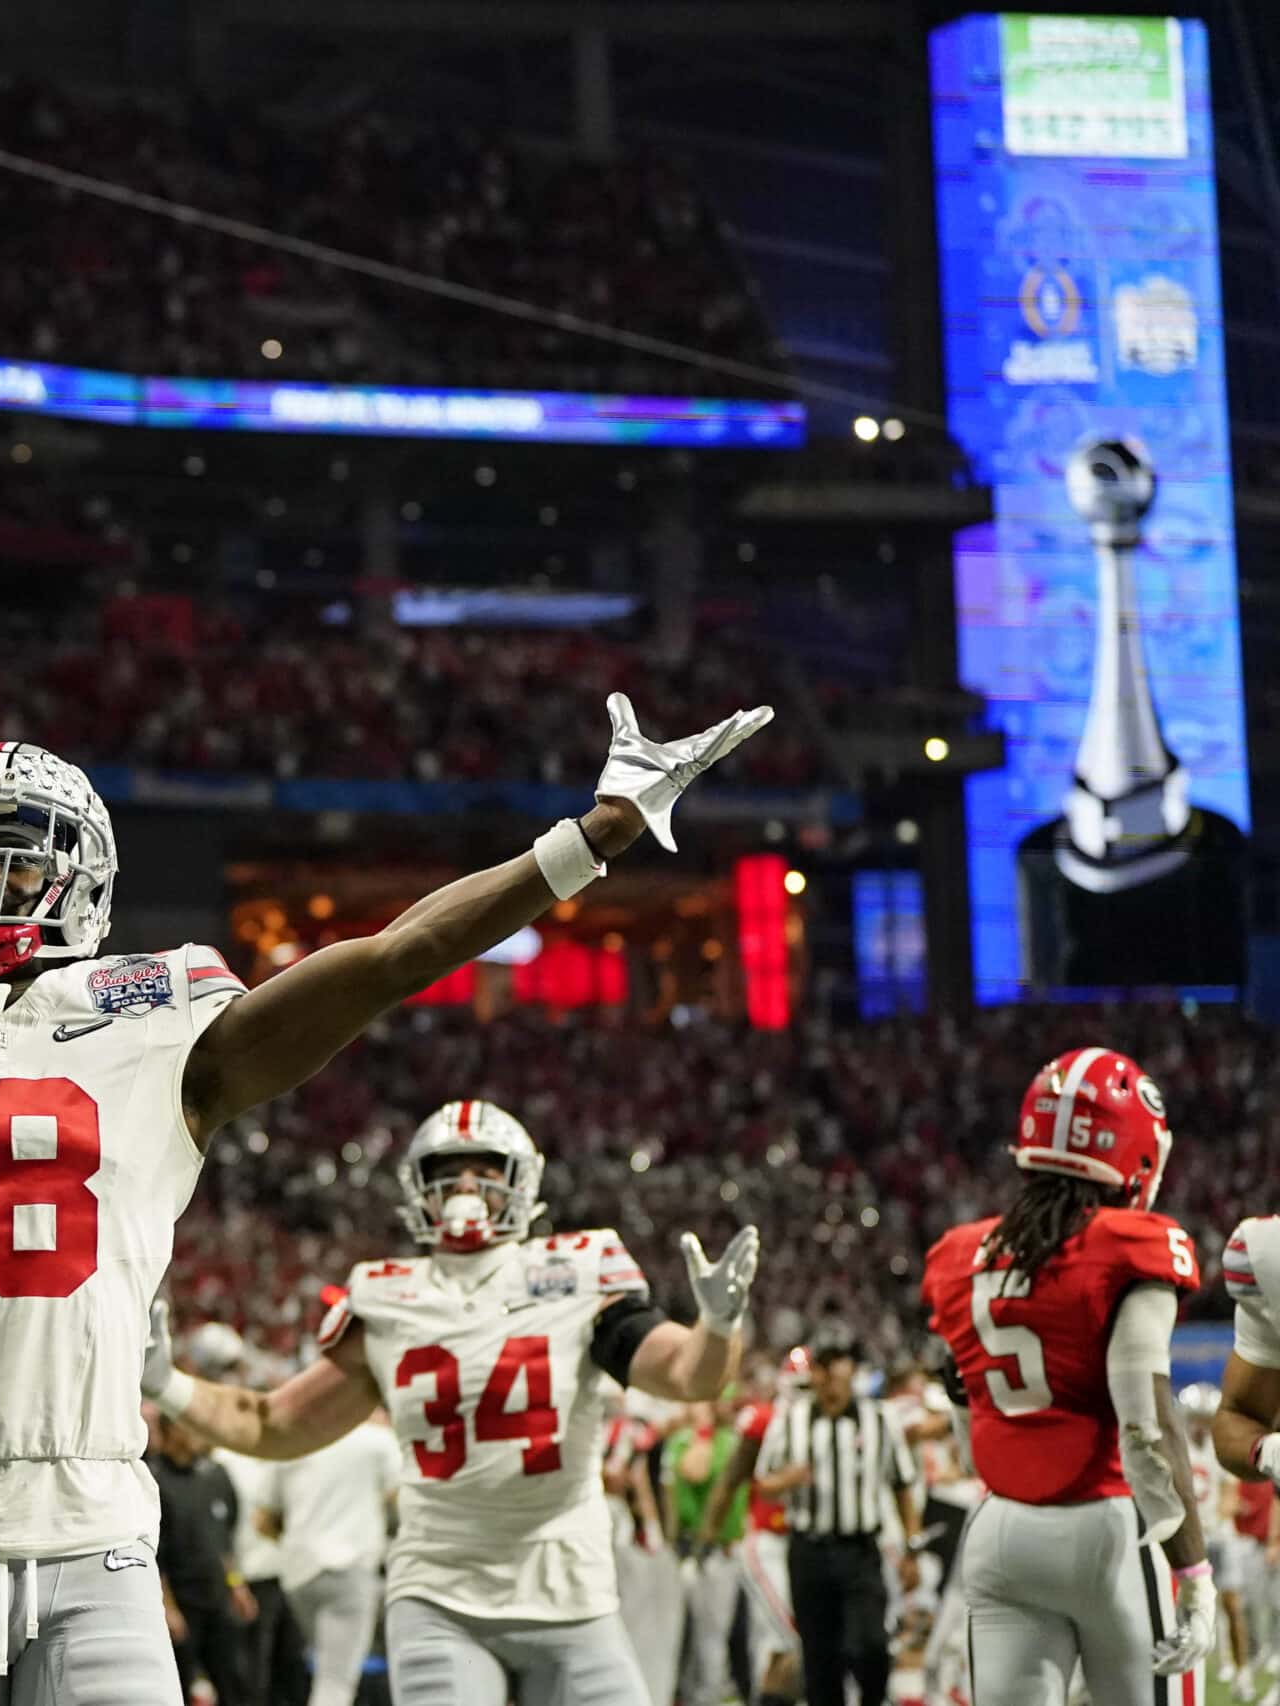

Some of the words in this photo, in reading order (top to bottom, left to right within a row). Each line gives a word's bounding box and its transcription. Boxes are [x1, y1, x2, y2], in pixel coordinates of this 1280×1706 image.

[95, 976, 169, 1009] PEACH
[1071, 1115, 1093, 1148] 5
[1167, 1227, 1194, 1277] 5
[971, 1268, 1054, 1417] 5
[394, 1335, 562, 1482] 34
